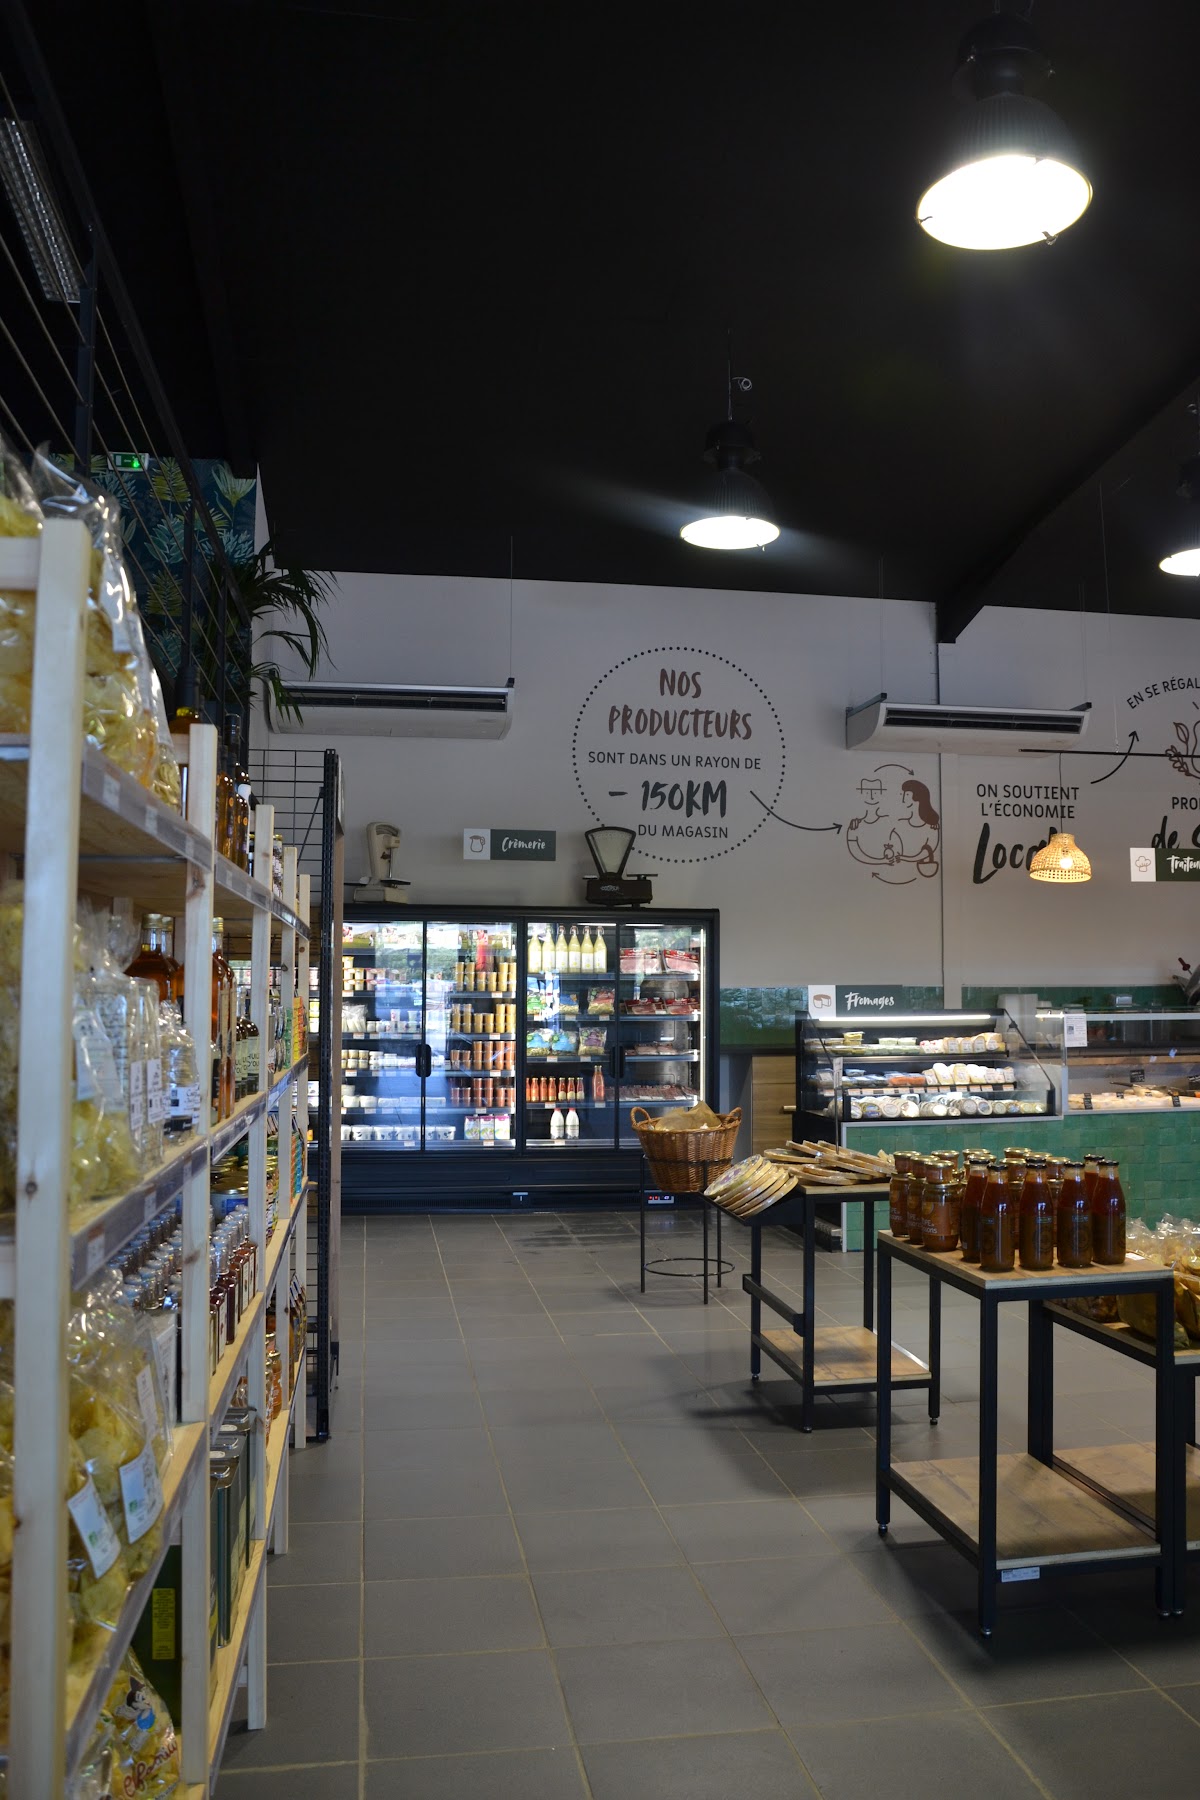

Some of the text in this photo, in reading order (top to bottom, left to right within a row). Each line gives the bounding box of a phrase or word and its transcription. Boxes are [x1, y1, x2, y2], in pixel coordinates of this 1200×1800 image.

[659, 668, 702, 698] NOS
[1126, 691, 1145, 709] EN
[1144, 683, 1161, 699] SE
[608, 704, 752, 740] PRODUCTEURS
[588, 751, 761, 770] SONT DANS UN RAYON DE
[641, 779, 727, 818] 150KM
[976, 783, 1080, 801] ON SOUTIENT
[1171, 796, 1200, 810] PRO
[637, 824, 728, 839] DU MAGASIN
[501, 836, 546, 852] Crèmerie
[845, 991, 895, 1011] Fromages
